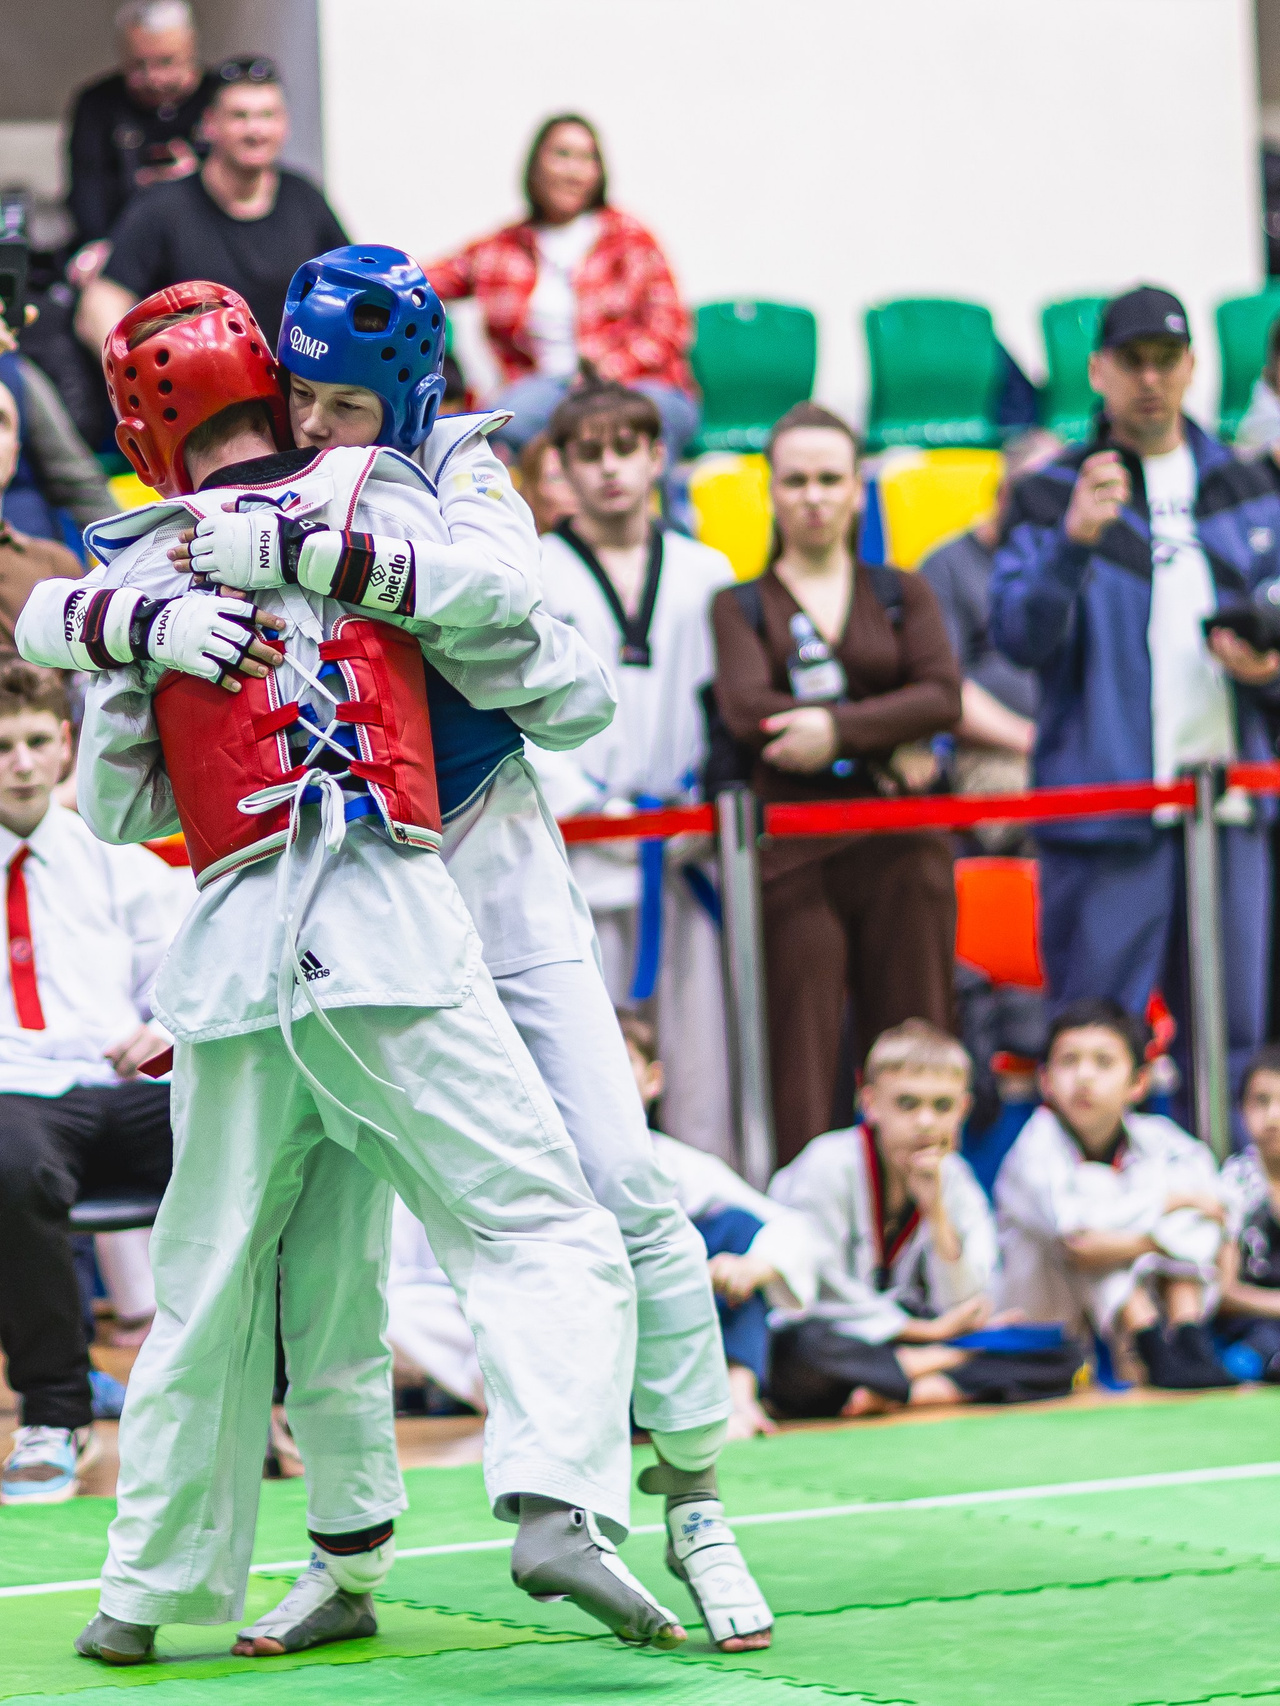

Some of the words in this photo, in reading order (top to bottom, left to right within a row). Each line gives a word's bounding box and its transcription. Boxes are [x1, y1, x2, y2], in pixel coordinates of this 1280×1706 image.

[290, 325, 329, 360] OLIMP
[259, 530, 271, 569] KHAN
[377, 554, 407, 604] Daedo
[64, 590, 87, 642] Daedo
[156, 609, 171, 646] KHAN
